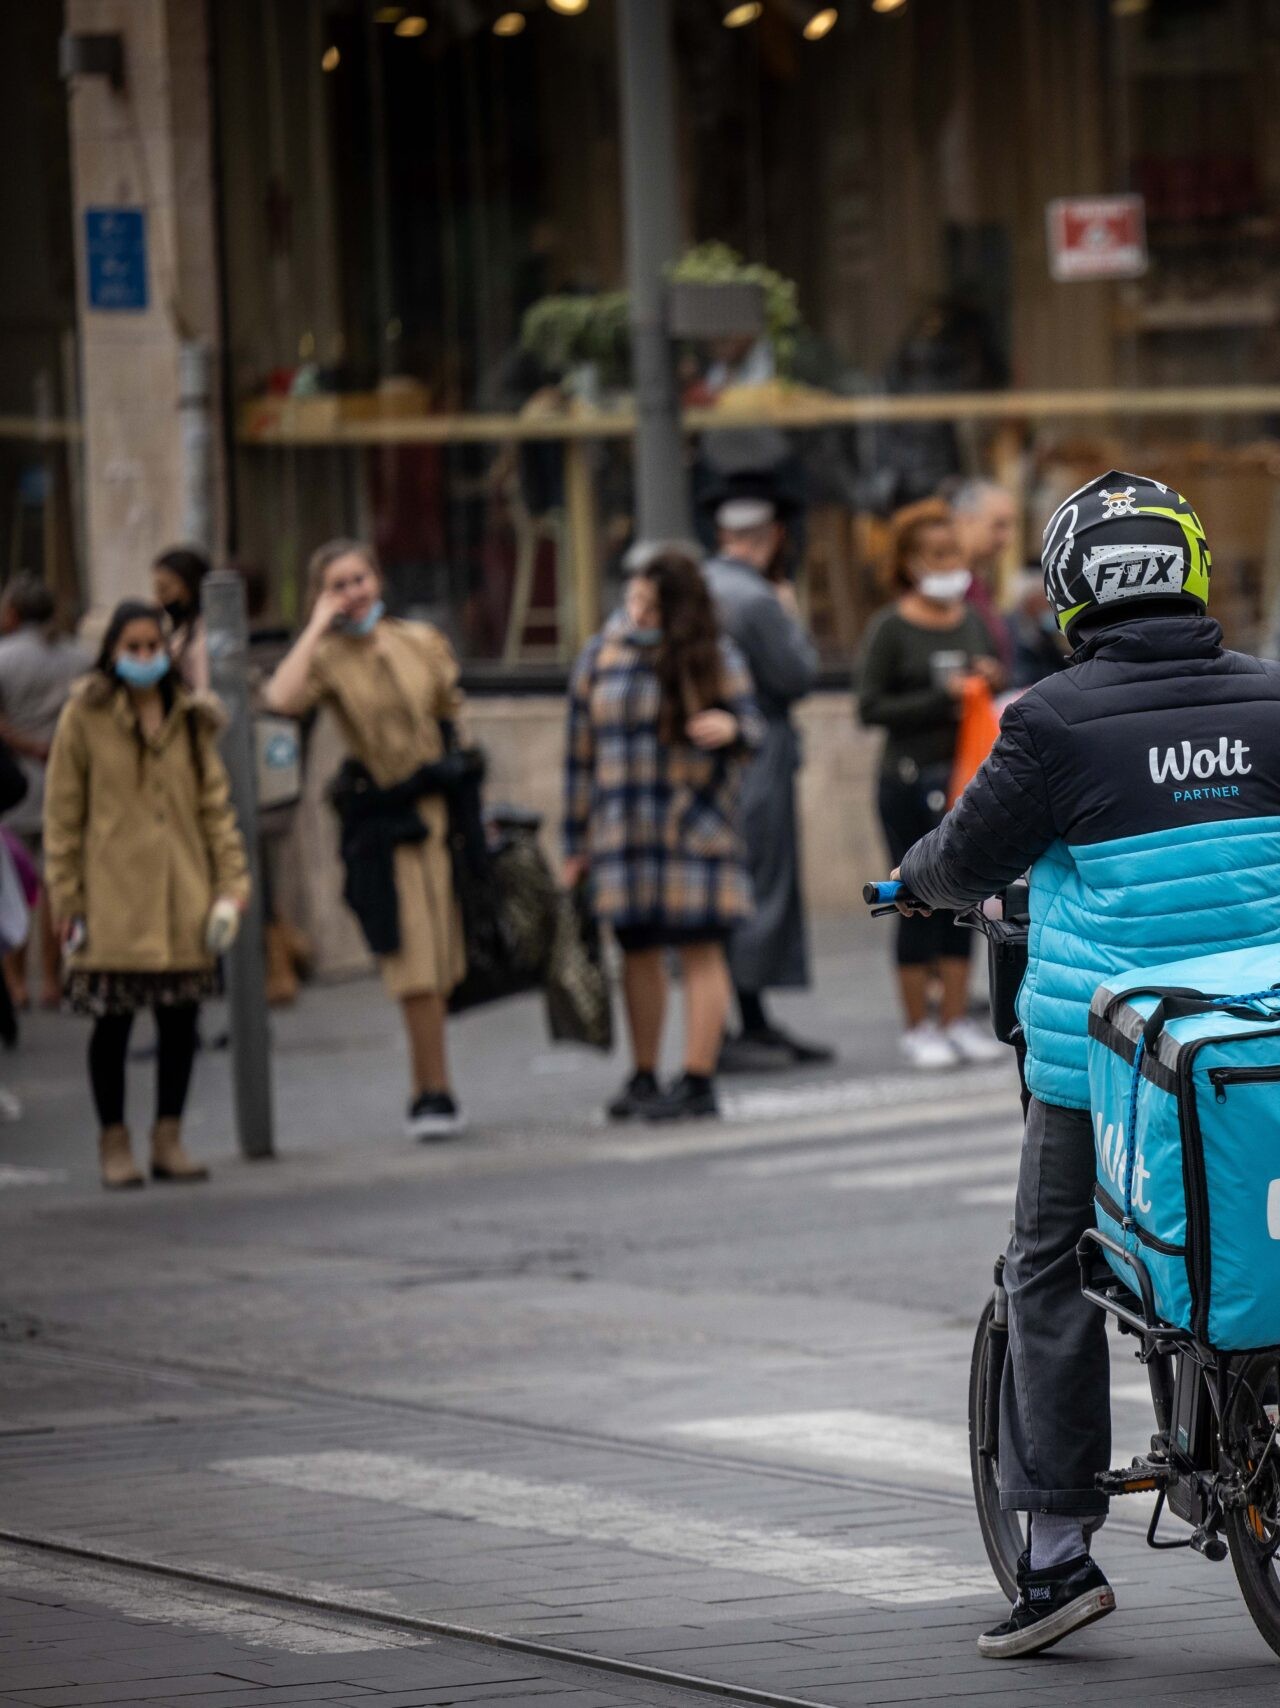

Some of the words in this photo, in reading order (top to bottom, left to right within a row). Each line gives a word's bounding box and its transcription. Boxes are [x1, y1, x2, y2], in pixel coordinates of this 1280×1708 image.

[1095, 553, 1178, 593] FOX
[1149, 736, 1252, 784] Wolt
[1173, 785, 1240, 802] PARTNER
